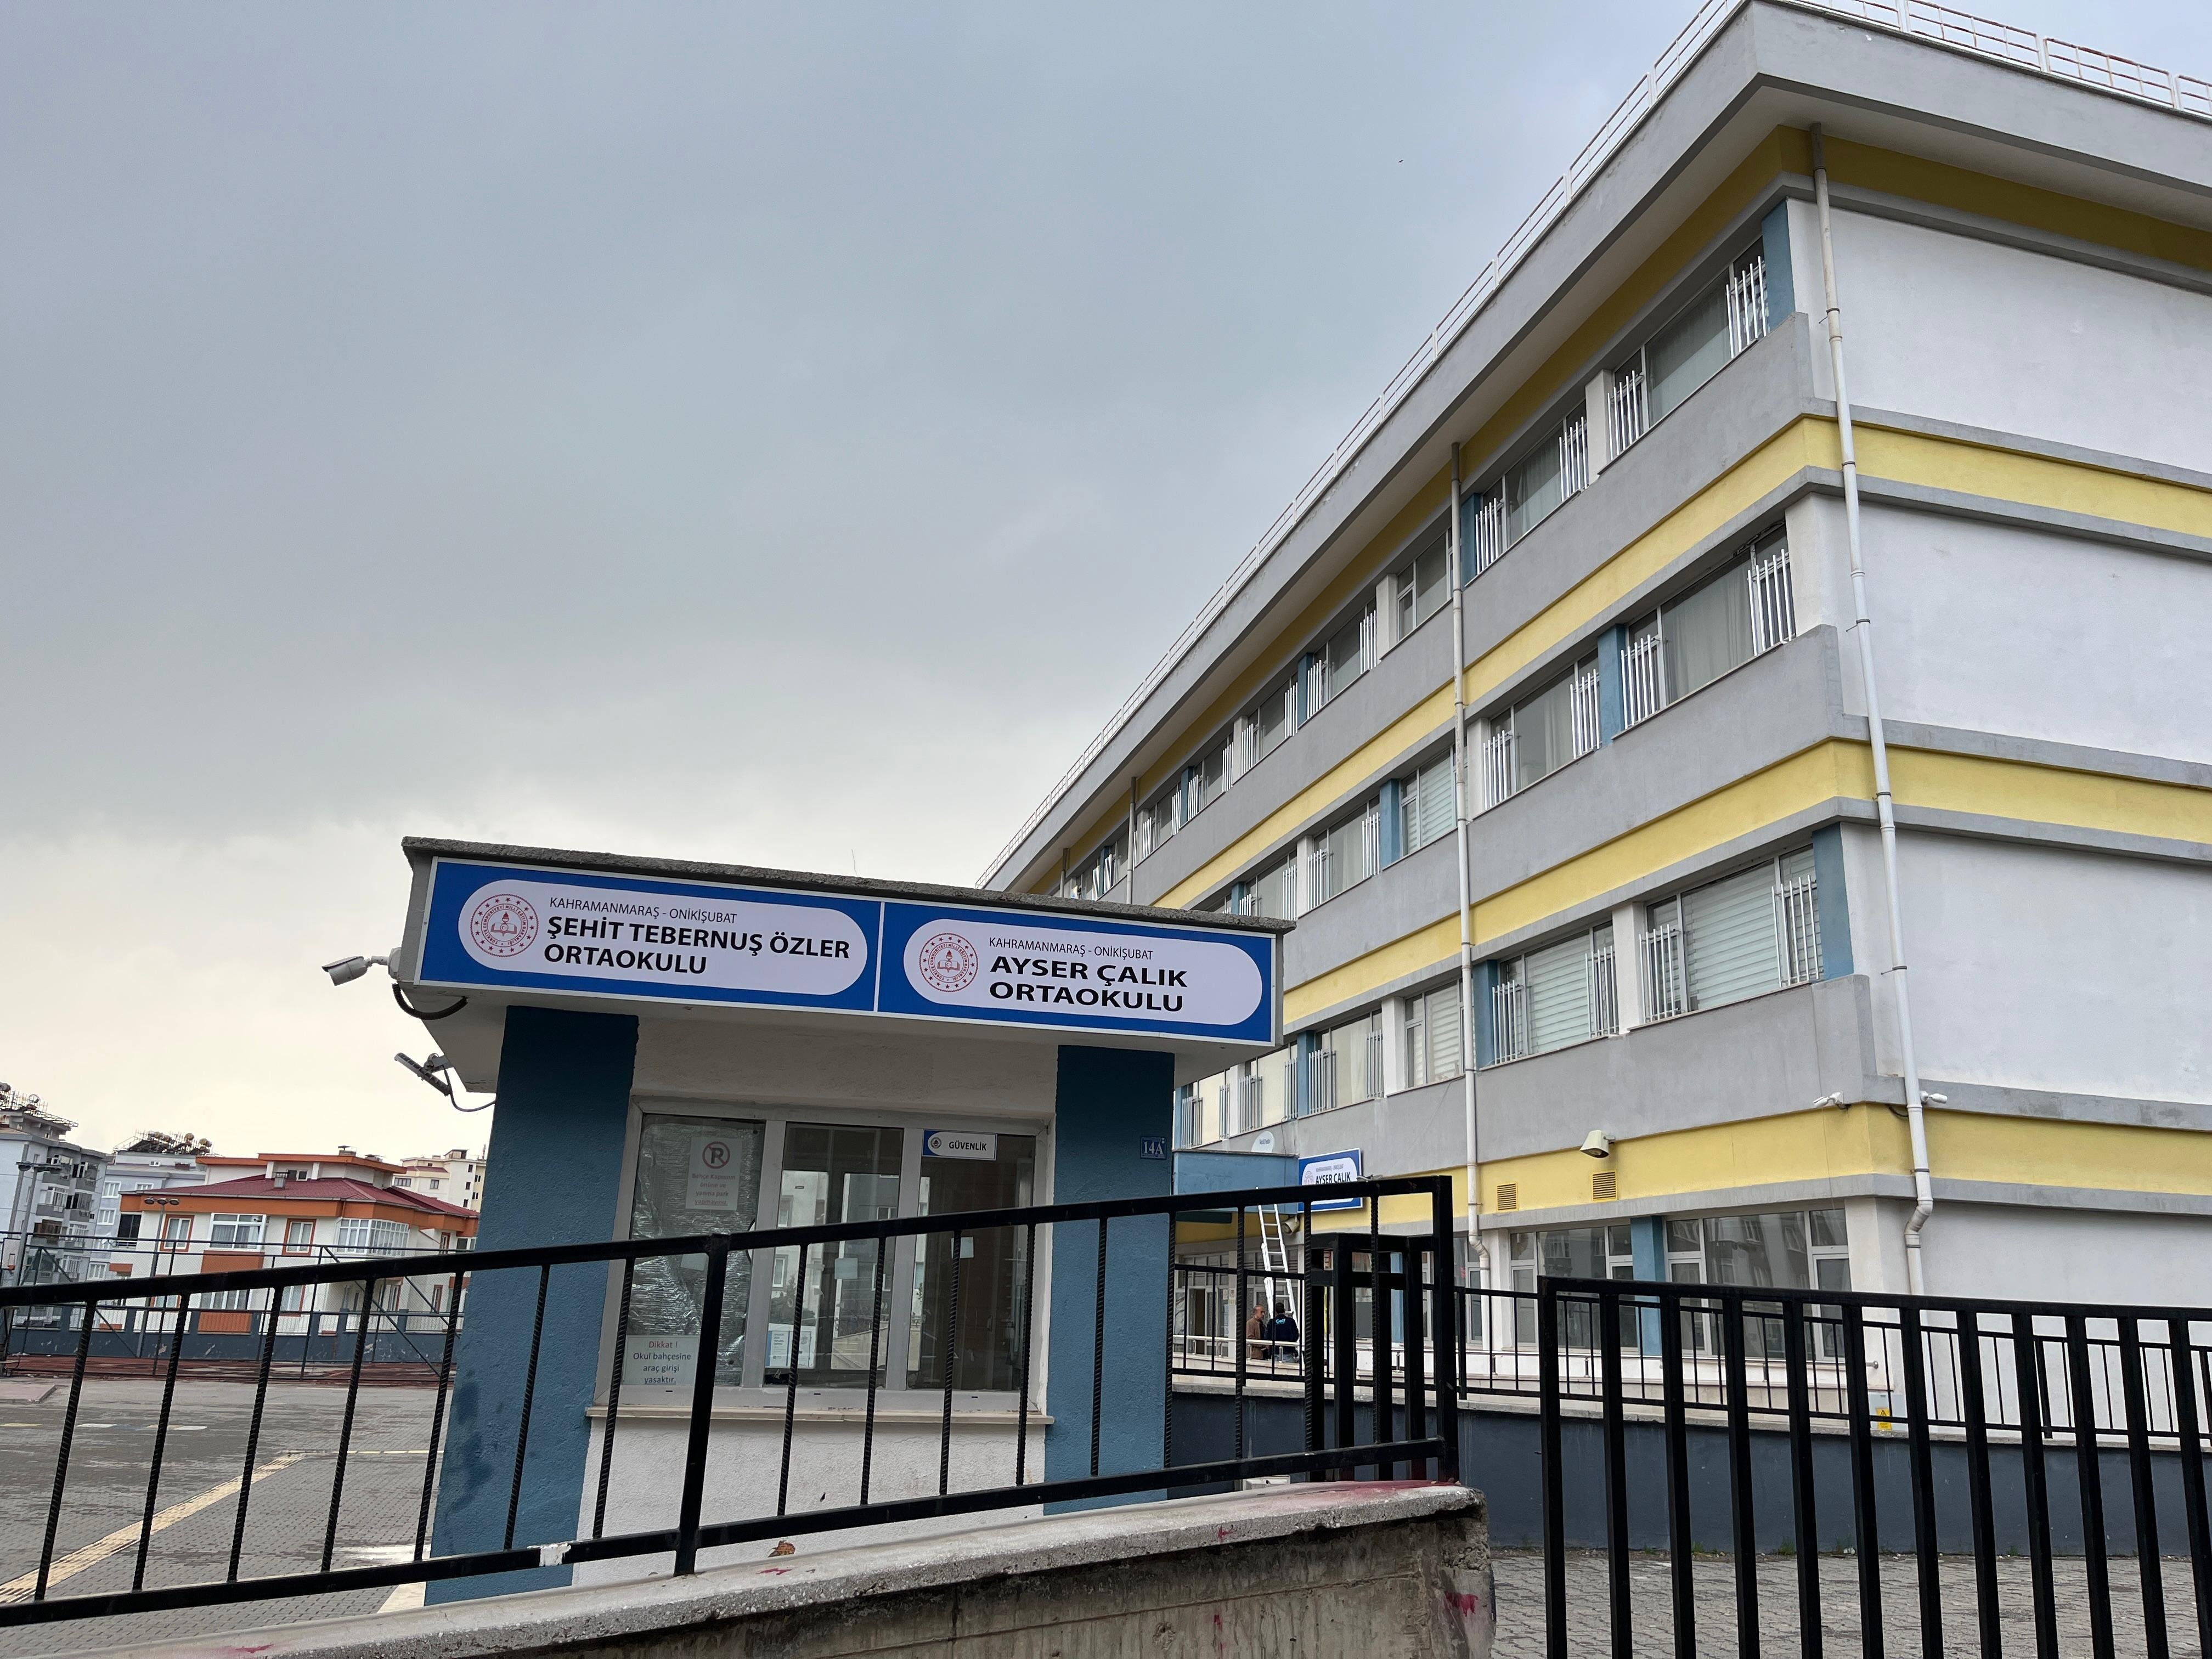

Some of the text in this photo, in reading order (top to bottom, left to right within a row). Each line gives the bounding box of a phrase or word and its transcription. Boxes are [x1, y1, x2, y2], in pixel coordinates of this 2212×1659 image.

[550, 897, 659, 919] KAHRAMANMARAŞ
[669, 907, 737, 923] ONİKİŞUBAT
[547, 916, 850, 958] ŞEHİT TEBERNUŞ ÖZLER
[989, 936, 1086, 957] KAHRAMANMARAŞ
[1094, 945, 1154, 960] ONİKİŞUBAT
[544, 944, 707, 974] ORTAOKULU
[990, 956, 1188, 988] AYSER ÇALIK
[989, 981, 1183, 1012] ORTAOKULU
[949, 1140, 987, 1151] GÜVENLİK
[1144, 1141, 1164, 1155] 14A
[1315, 1173, 1332, 1184] AYSER
[653, 1352, 691, 1361] bahçesine
[661, 1364, 680, 1373] girişi
